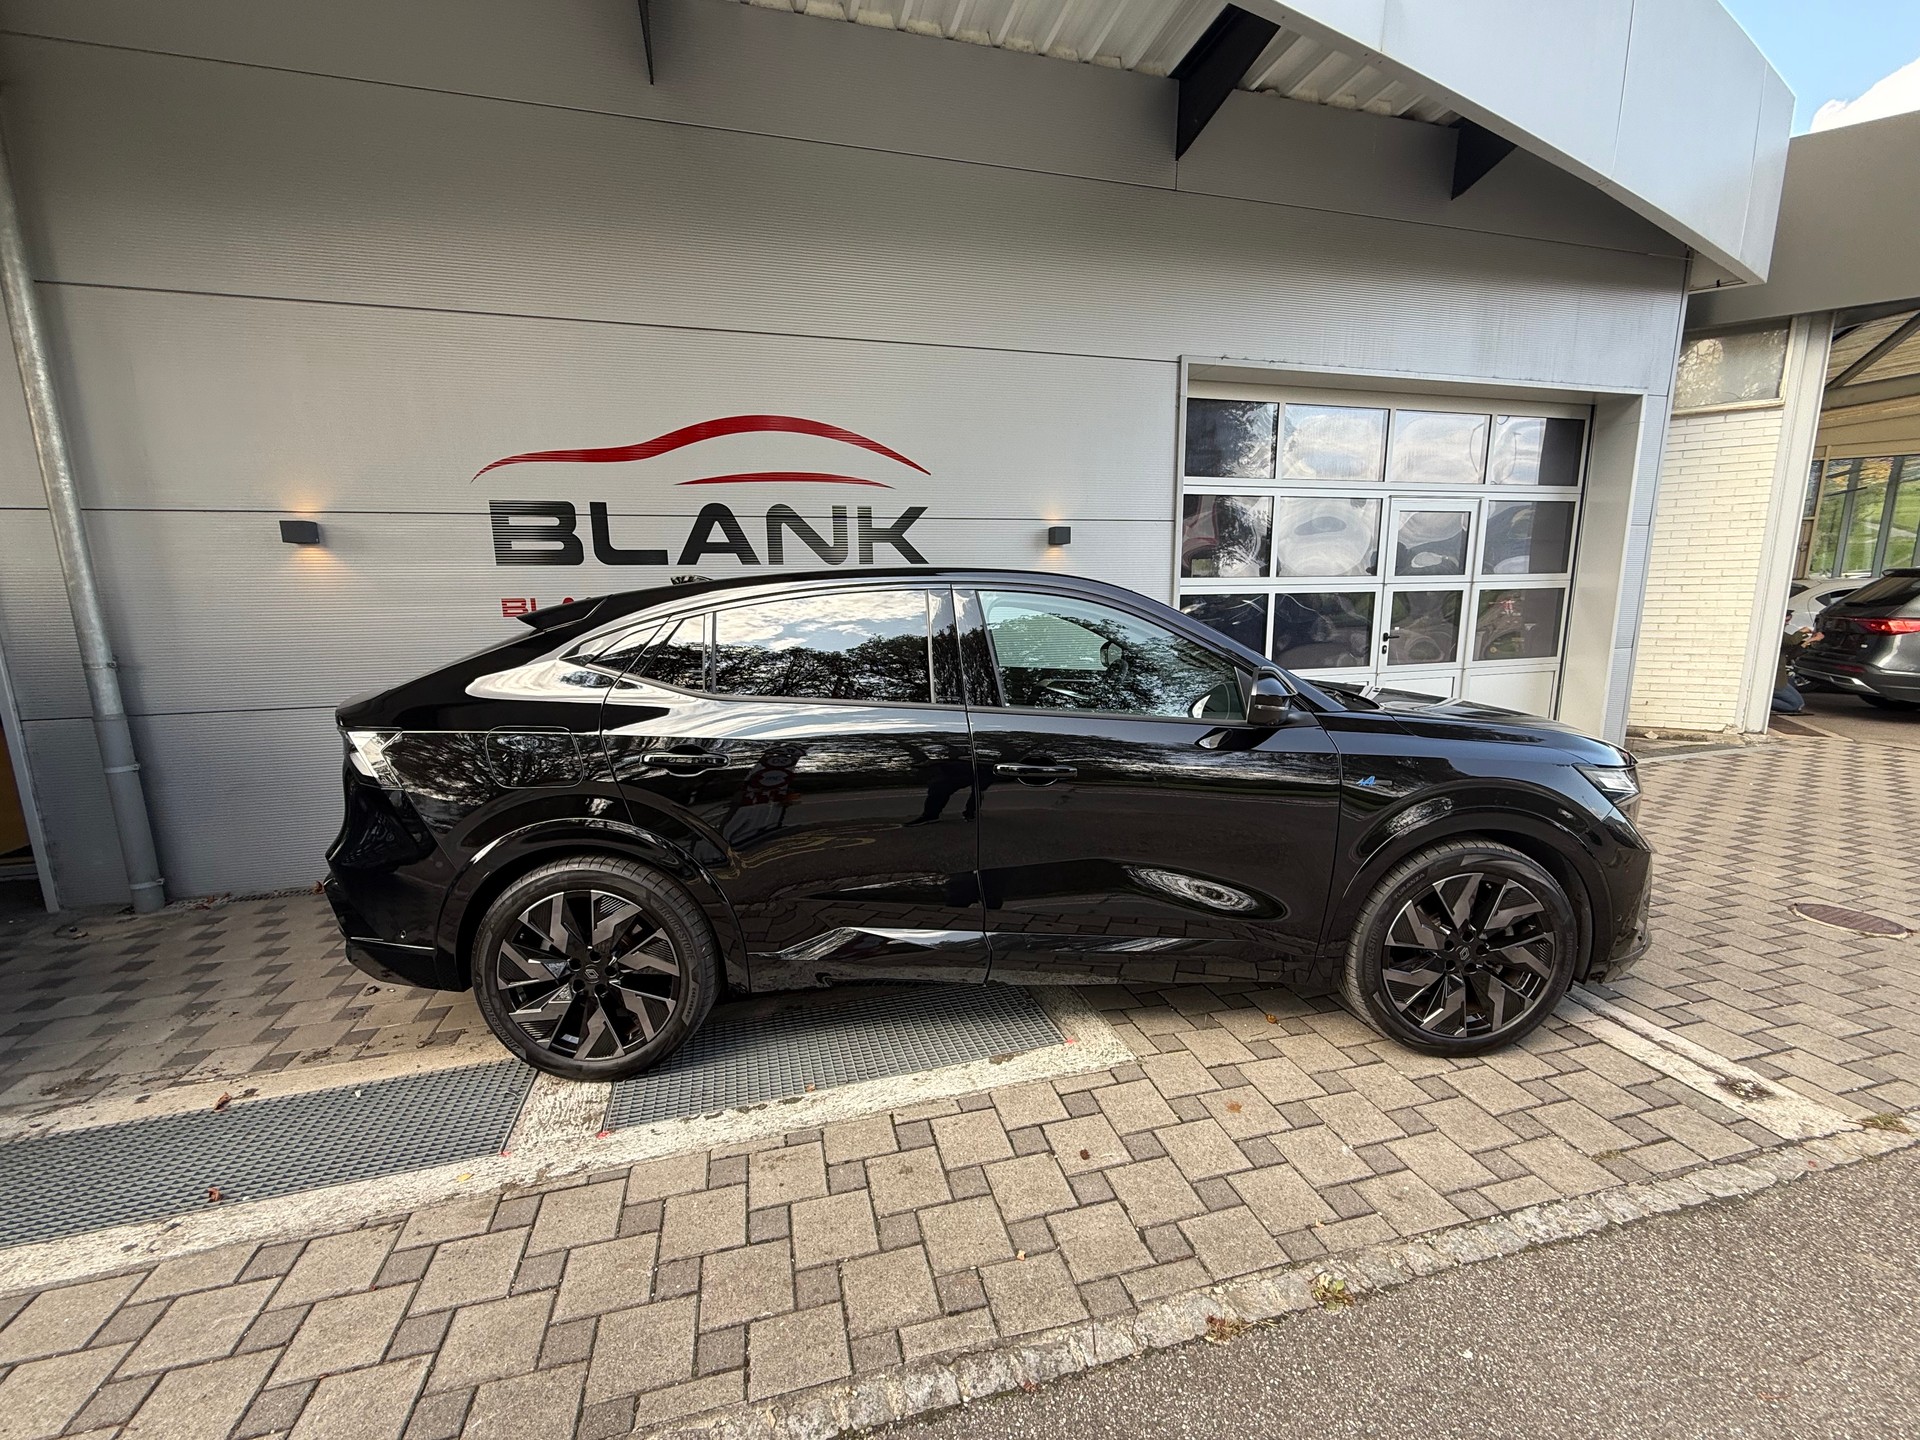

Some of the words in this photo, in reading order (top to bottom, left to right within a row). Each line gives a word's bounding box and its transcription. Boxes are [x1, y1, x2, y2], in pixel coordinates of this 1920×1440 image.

[489, 499, 929, 566] BLANK
[655, 900, 697, 962] BRIDGESTONE
[1364, 919, 1384, 986] BRIDGESTONE
